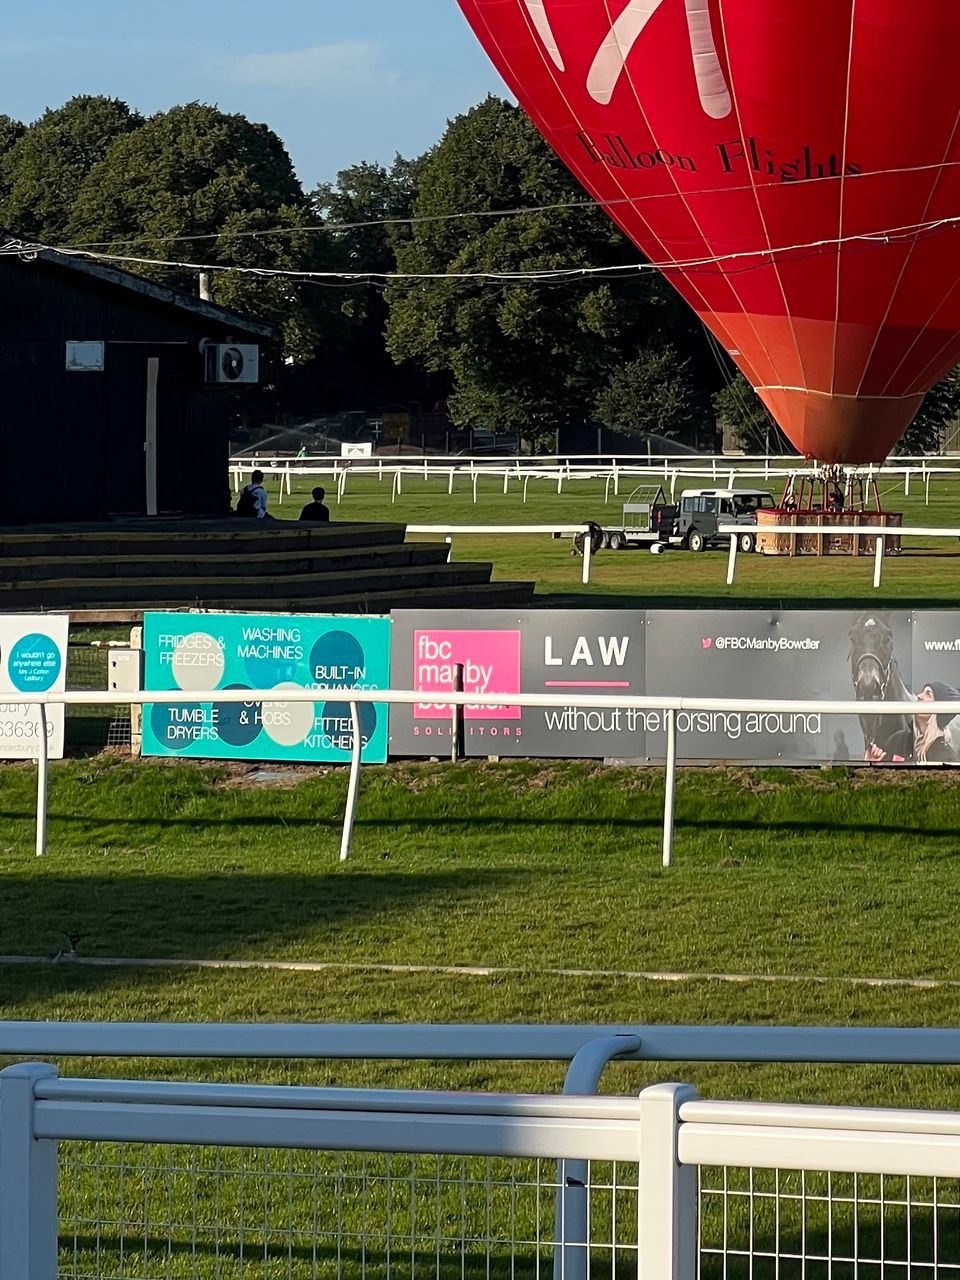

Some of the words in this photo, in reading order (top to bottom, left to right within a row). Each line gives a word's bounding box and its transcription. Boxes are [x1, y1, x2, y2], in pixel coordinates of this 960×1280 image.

[575, 130, 697, 172] Balloon
[715, 136, 861, 183] Flights
[158, 634, 212, 649] FRIDGES
[217, 636, 226, 649] &
[242, 627, 301, 643] WASHING
[418, 634, 452, 660] fbc
[544, 636, 629, 666] LAW
[715, 637, 820, 652] @FBCManbyBowdler
[159, 652, 225, 667] FREEZERS
[237, 645, 303, 660] MACHINES
[315, 665, 366, 679] BUILT-IN
[167, 708, 219, 723] TUMBLE
[239, 712, 249, 725] &
[254, 712, 291, 726] HOBS
[544, 707, 622, 732] without
[625, 707, 660, 732] the
[745, 712, 821, 734] around
[167, 726, 219, 741] DRYERS
[413, 727, 522, 736] SOLIITORS
